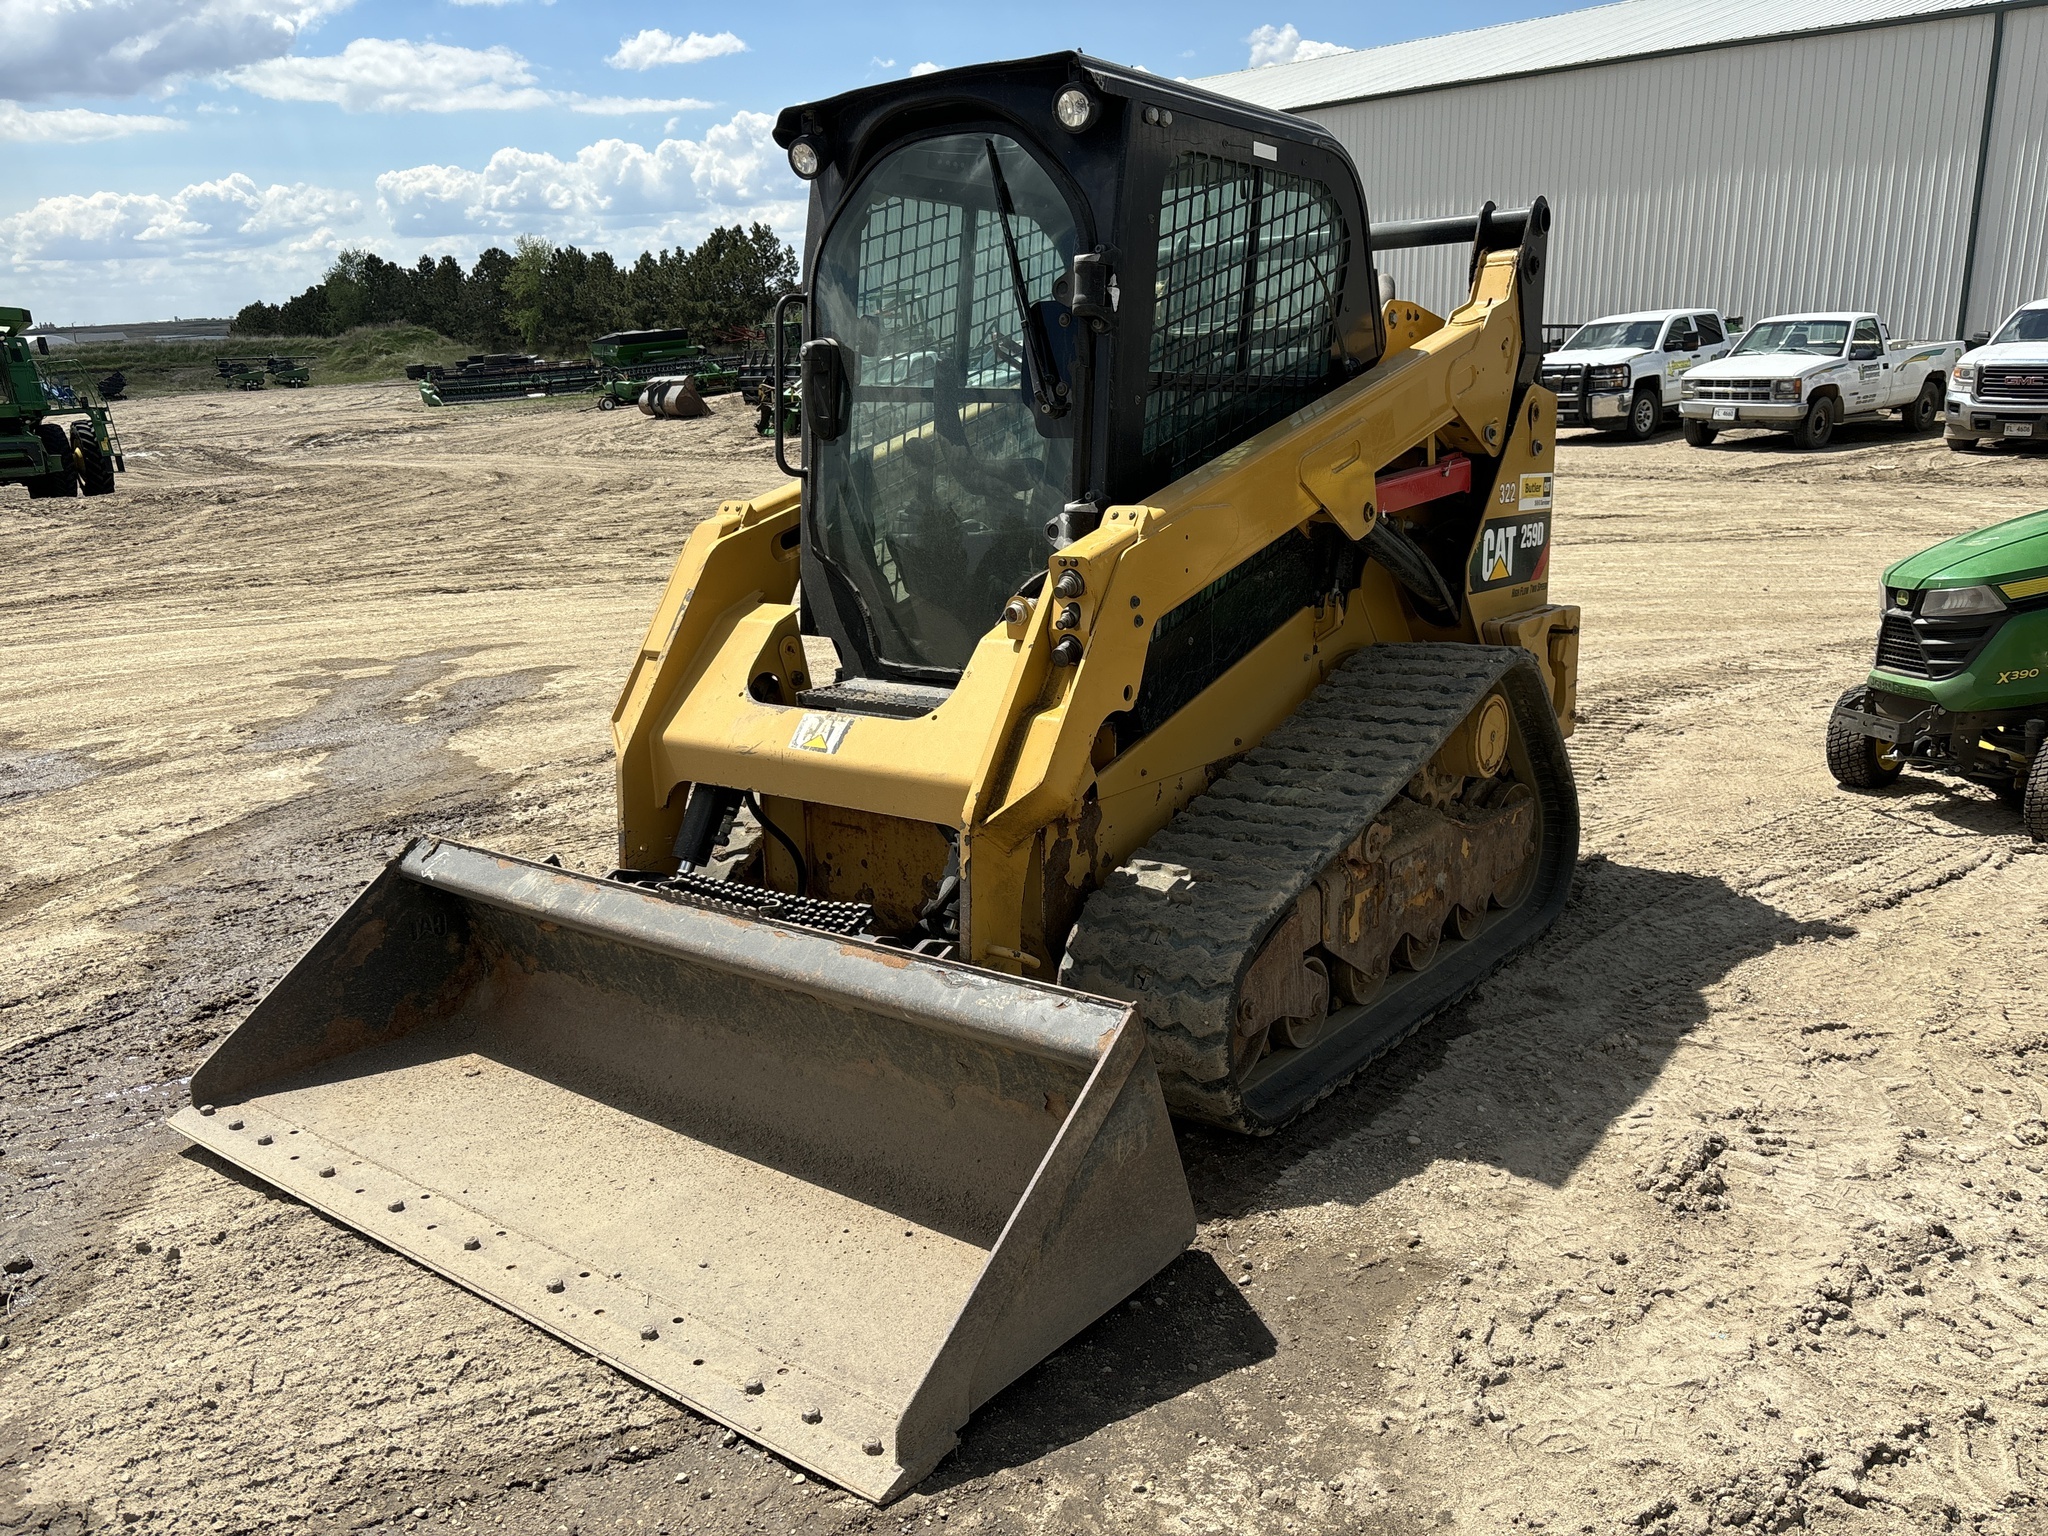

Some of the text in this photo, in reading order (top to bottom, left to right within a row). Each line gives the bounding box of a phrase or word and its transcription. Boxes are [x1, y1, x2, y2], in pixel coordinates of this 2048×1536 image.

[2004, 376, 2045, 386] GMC
[1499, 483, 1516, 504] 322
[1525, 482, 1542, 493] Butler
[1482, 522, 1544, 582] CAT 259D
[1996, 668, 2040, 685] X390
[1870, 679, 1893, 693] JOHN
[796, 714, 851, 754] CAT
